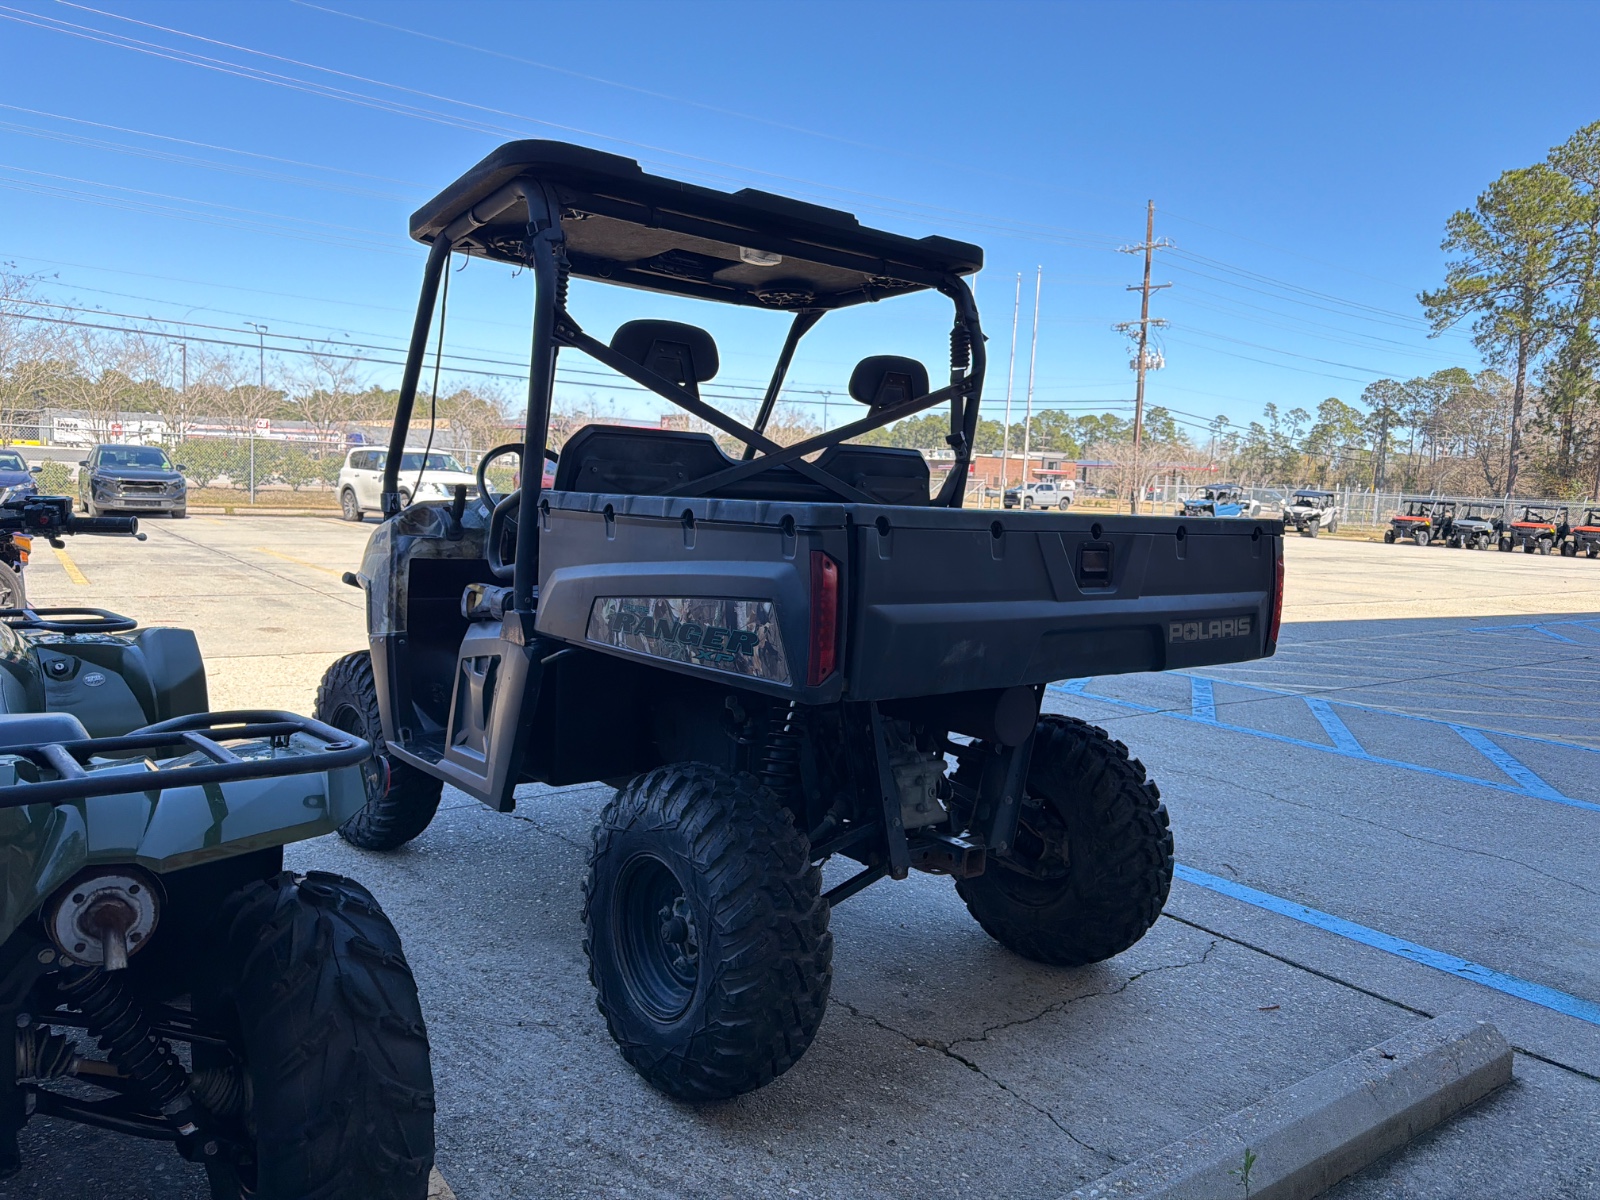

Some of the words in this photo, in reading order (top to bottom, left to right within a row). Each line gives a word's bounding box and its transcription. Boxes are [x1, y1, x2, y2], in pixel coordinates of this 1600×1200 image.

[611, 612, 759, 655] RANGER
[1169, 618, 1251, 644] POLARIS
[695, 649, 735, 662] XP
